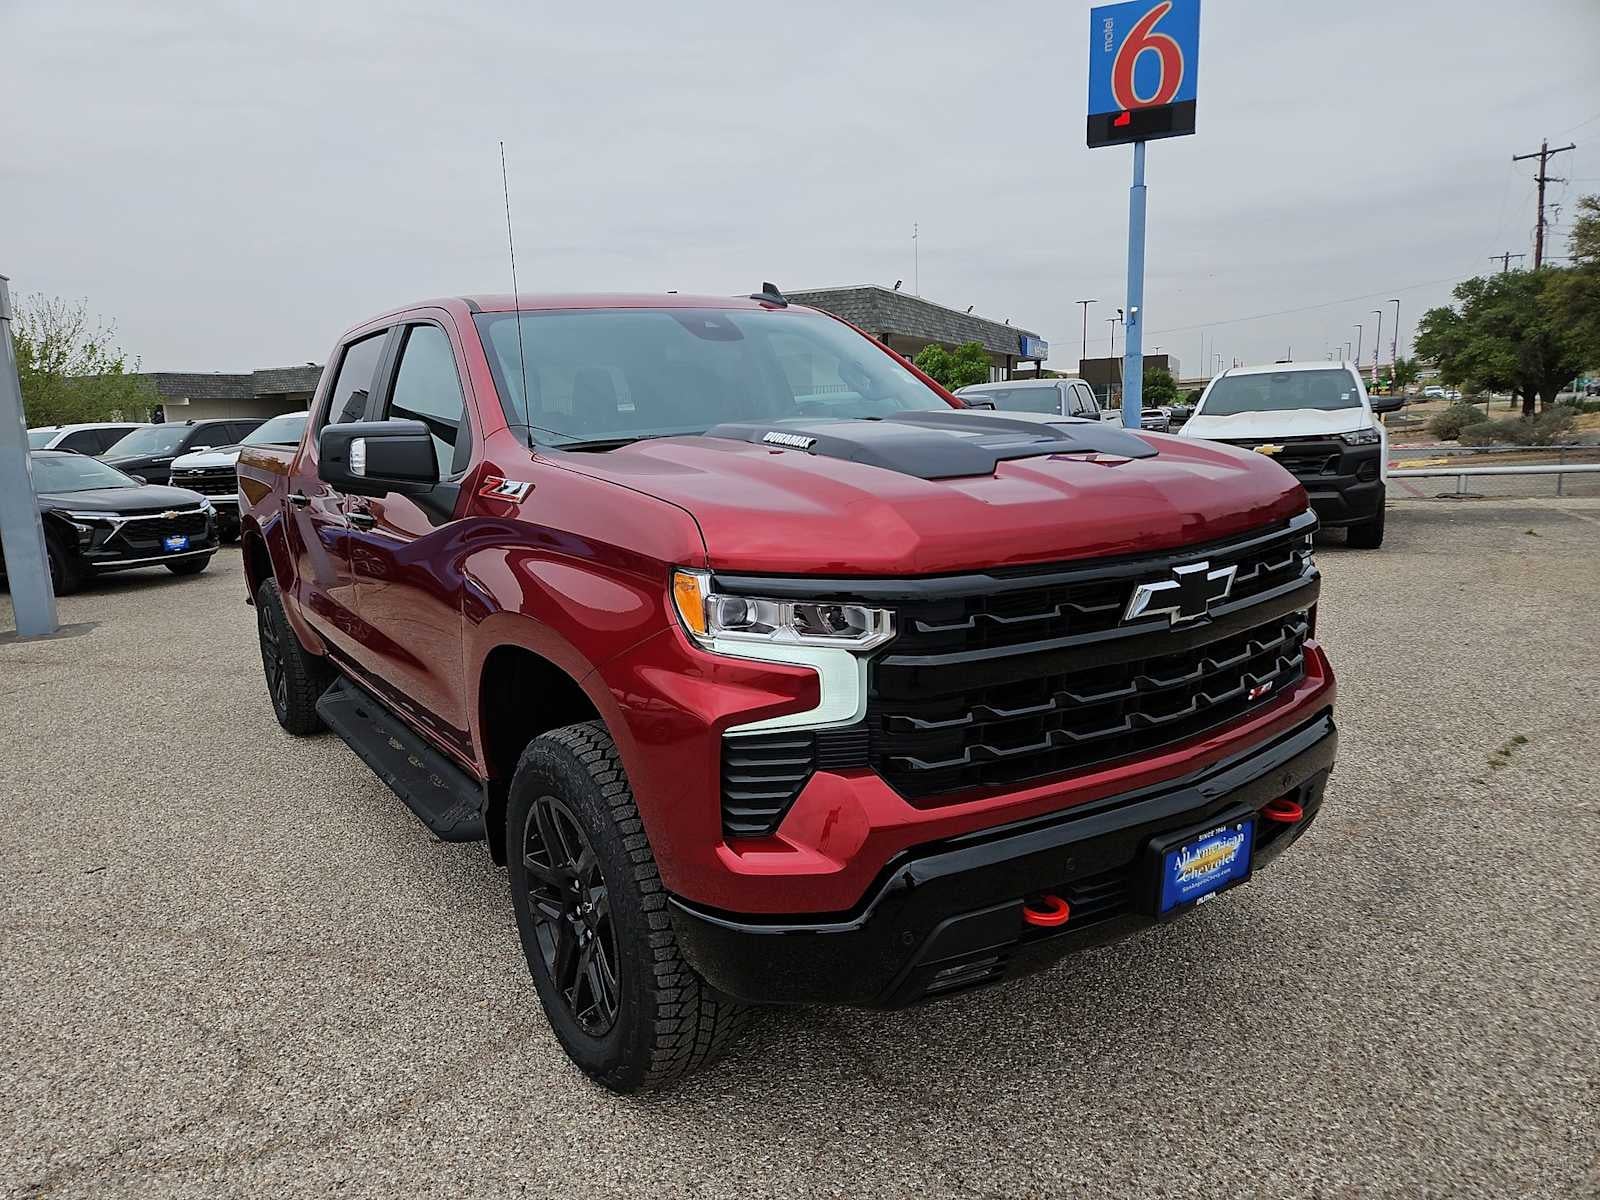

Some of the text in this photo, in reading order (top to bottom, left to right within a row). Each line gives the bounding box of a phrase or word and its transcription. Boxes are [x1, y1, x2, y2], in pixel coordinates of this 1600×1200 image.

[1103, 17, 1114, 53] motel
[1111, 0, 1184, 111] 6
[762, 431, 817, 449] DURAMAX
[479, 474, 536, 504] Z71
[1174, 833, 1245, 871] All American
[1182, 851, 1236, 882] Chevrolet
